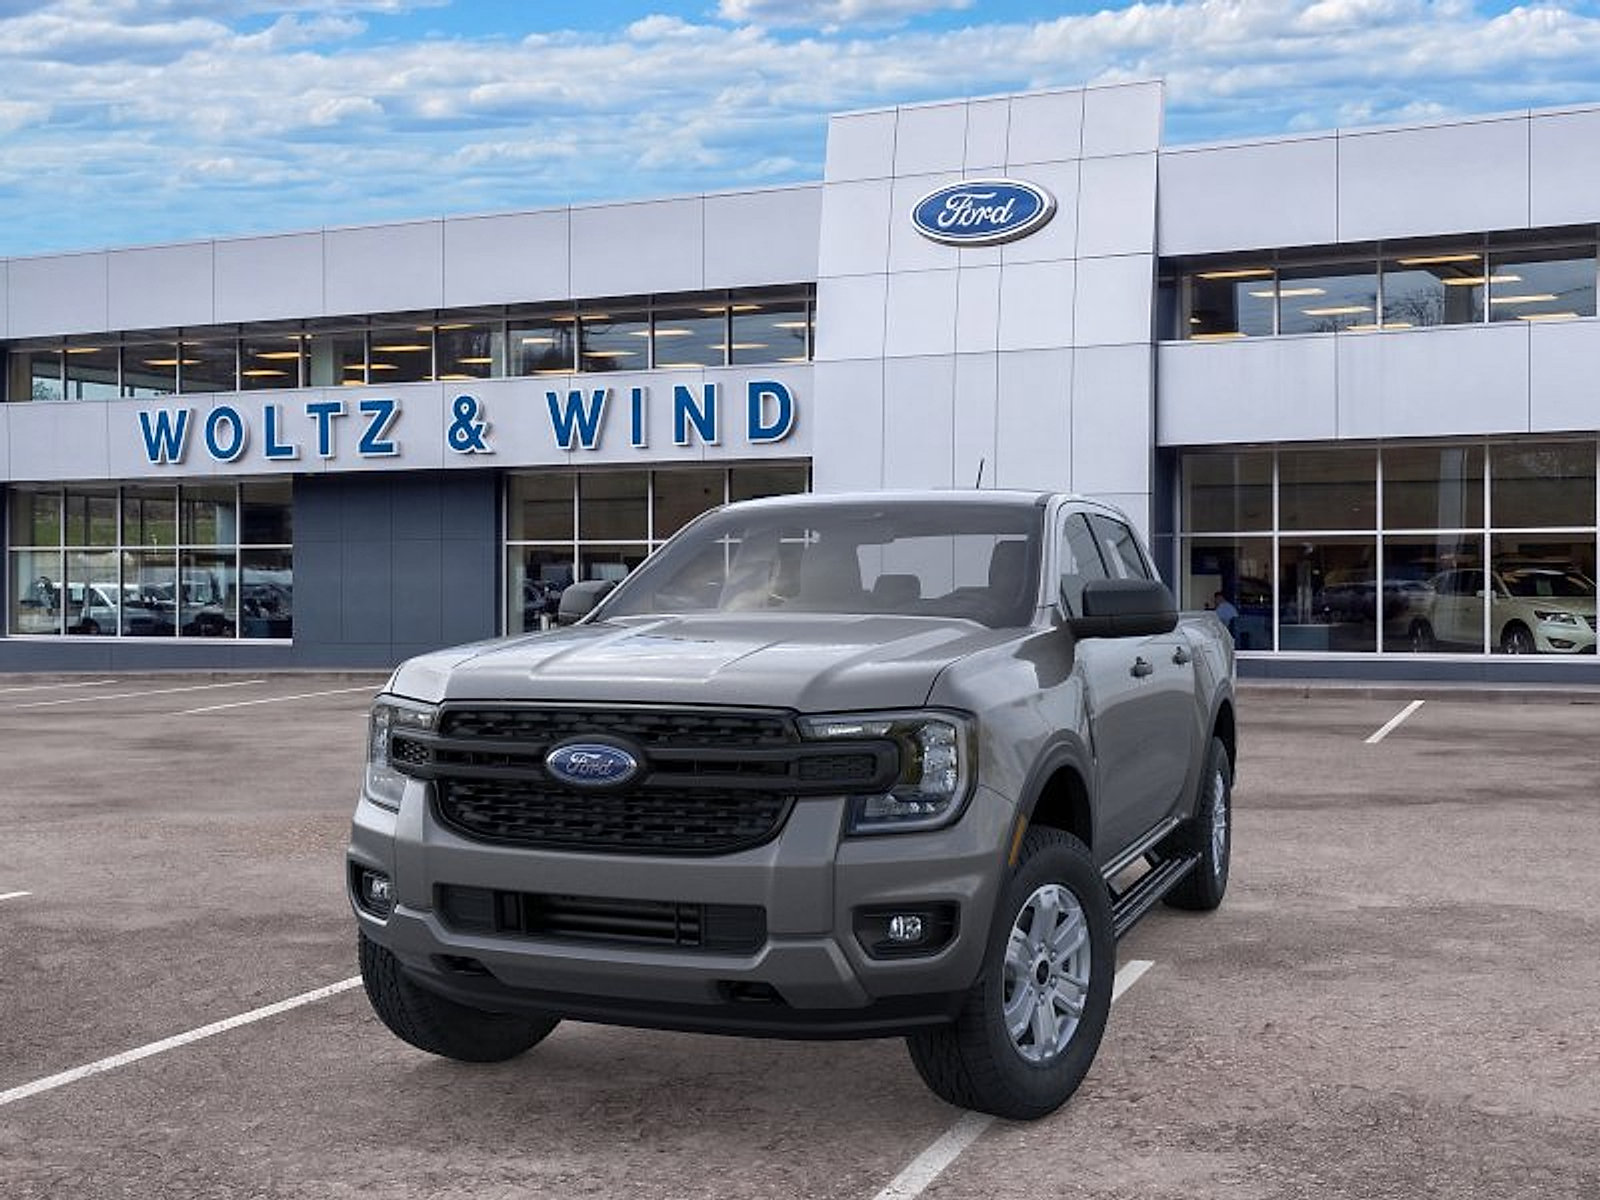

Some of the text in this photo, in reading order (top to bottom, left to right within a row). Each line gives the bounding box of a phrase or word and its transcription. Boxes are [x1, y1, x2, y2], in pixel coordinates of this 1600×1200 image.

[937, 192, 1015, 227] Ford
[138, 380, 797, 464] WOLTZ & WIND
[566, 752, 614, 775] Ford
